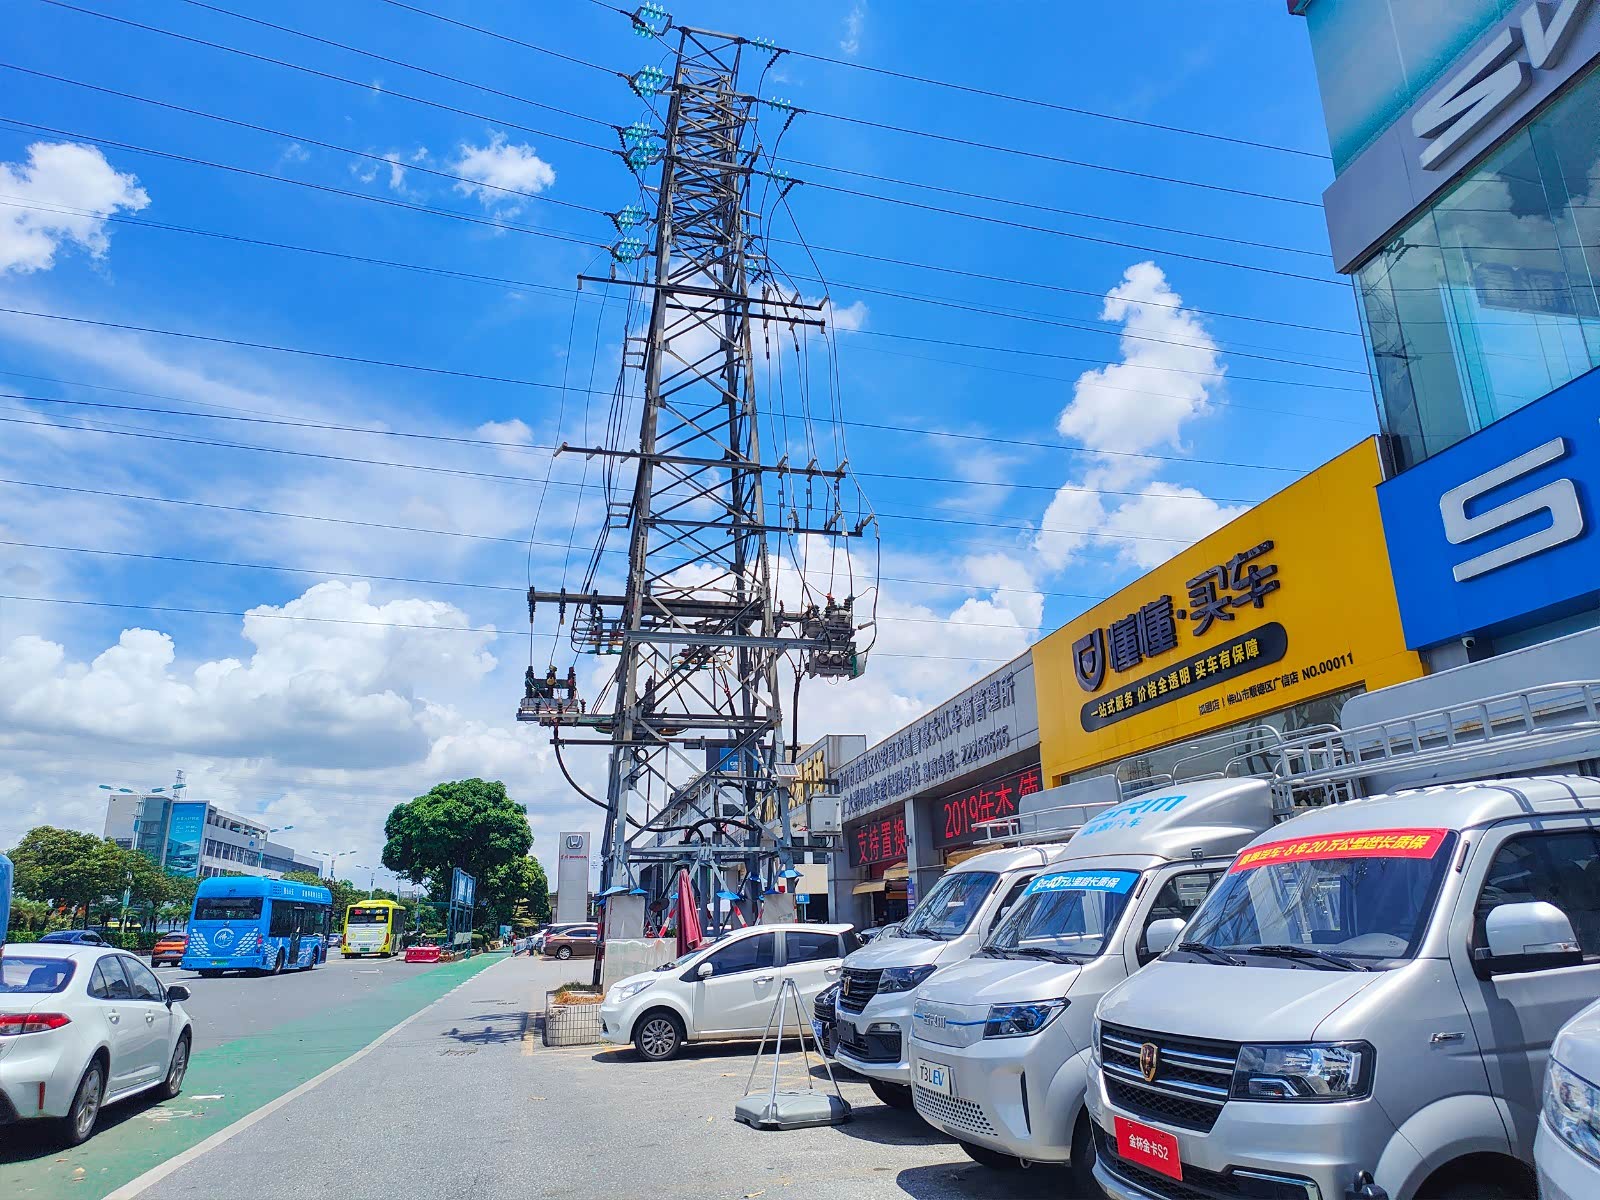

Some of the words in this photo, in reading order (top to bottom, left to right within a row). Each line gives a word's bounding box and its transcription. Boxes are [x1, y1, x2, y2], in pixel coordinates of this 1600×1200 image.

[1090, 691, 1136, 720] 一站式服务
[1136, 667, 1191, 702] 价格全透明
[1194, 638, 1260, 680] 买车有保障
[1301, 652, 1354, 681] NO.00011
[1129, 1133, 1169, 1161] 金杯金卡S2
